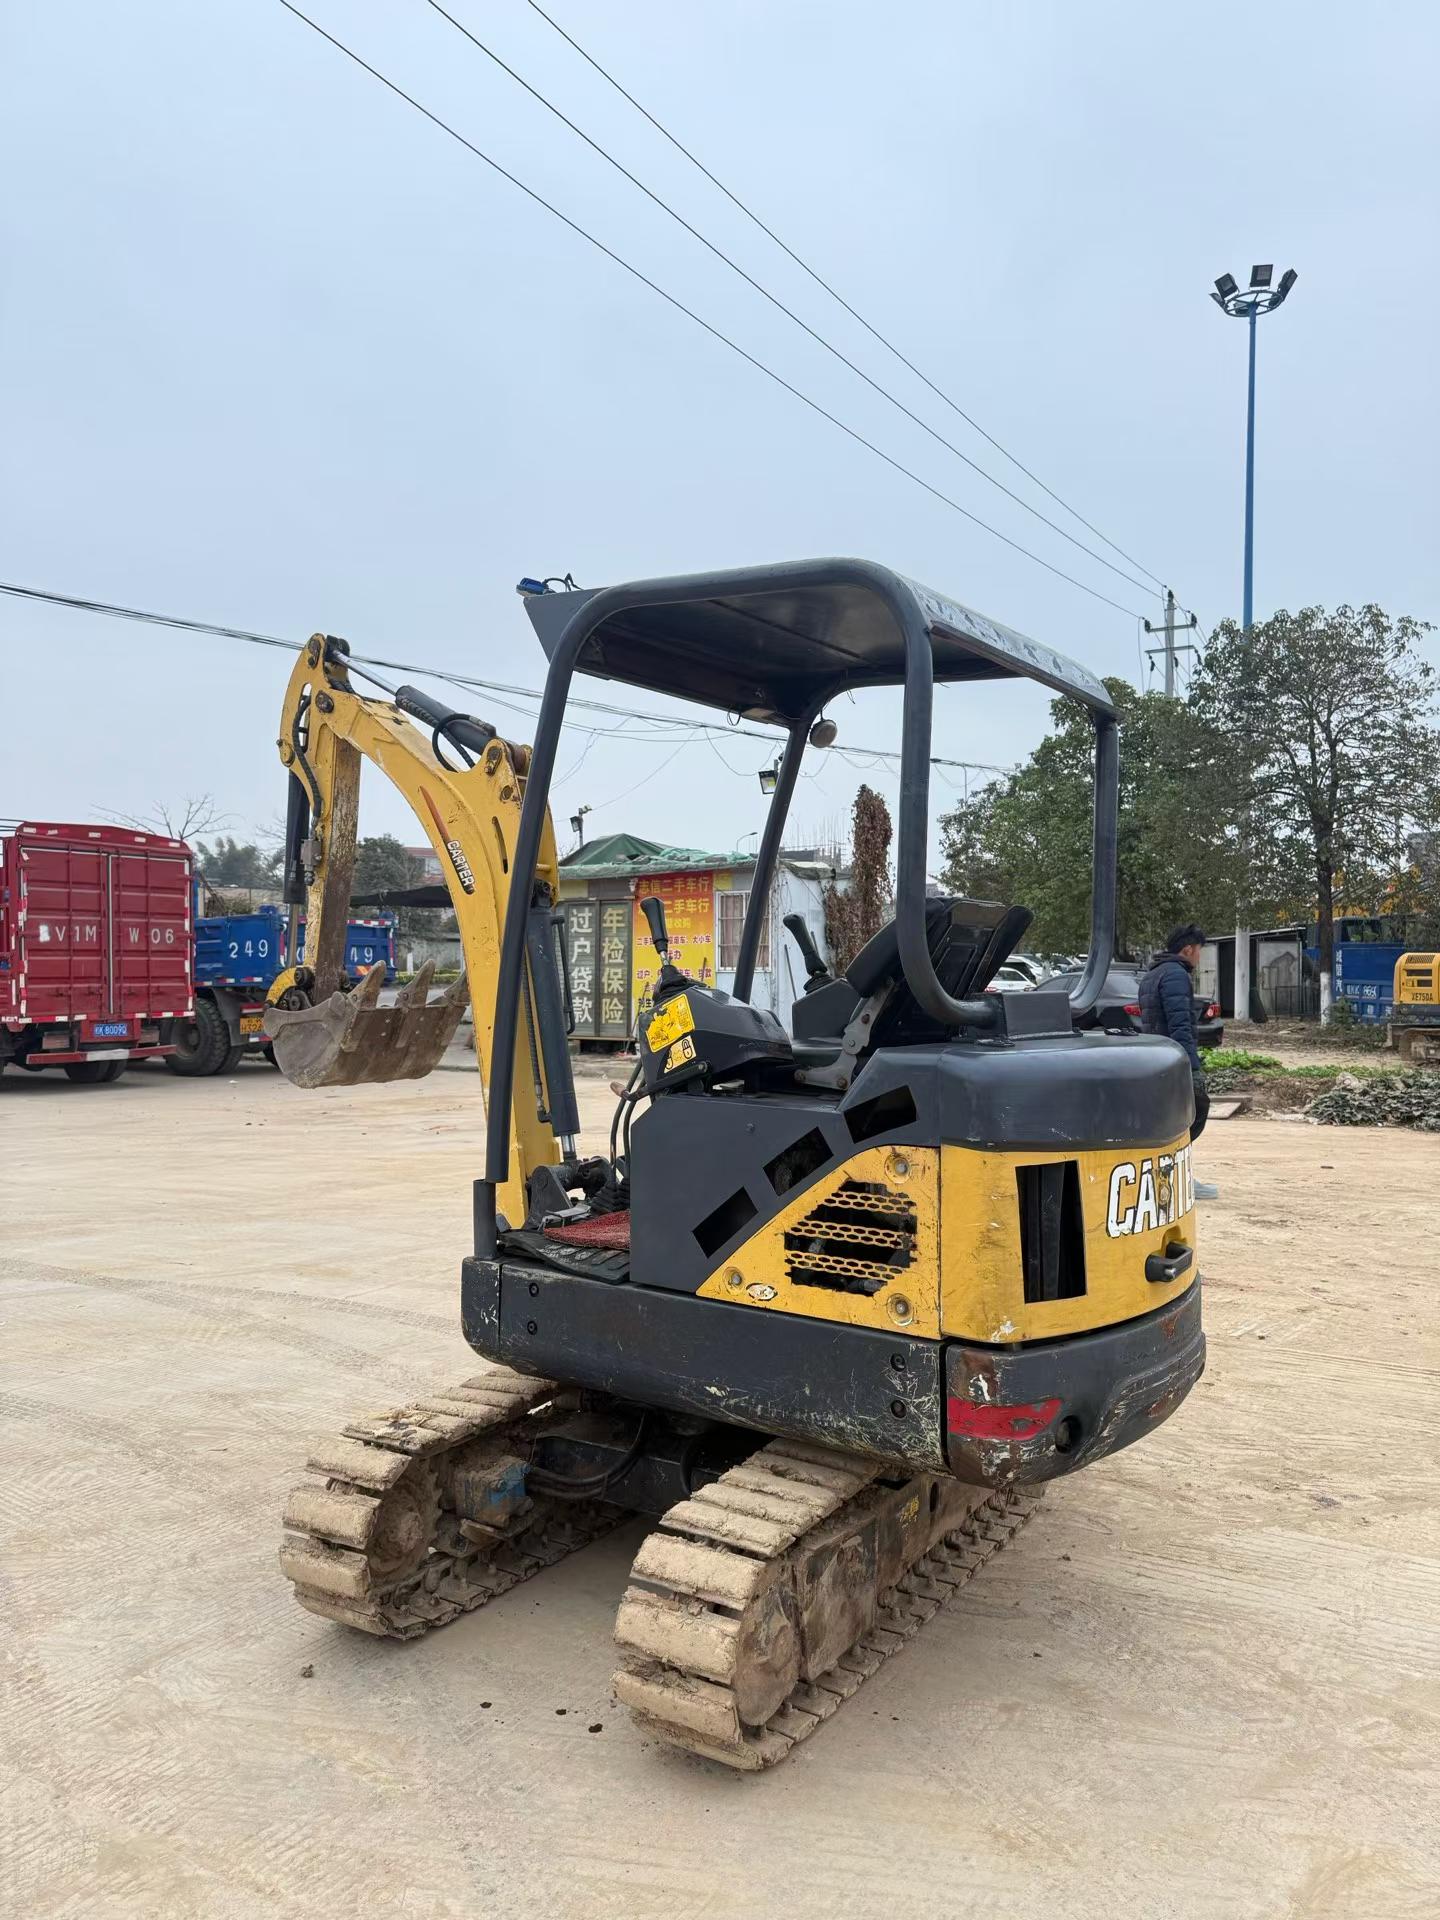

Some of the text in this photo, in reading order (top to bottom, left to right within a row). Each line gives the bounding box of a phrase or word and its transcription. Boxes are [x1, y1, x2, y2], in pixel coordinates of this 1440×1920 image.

[446, 839, 476, 887] CARTER
[570, 907, 593, 1024] 过户贷款
[601, 907, 626, 1025] 年检保险
